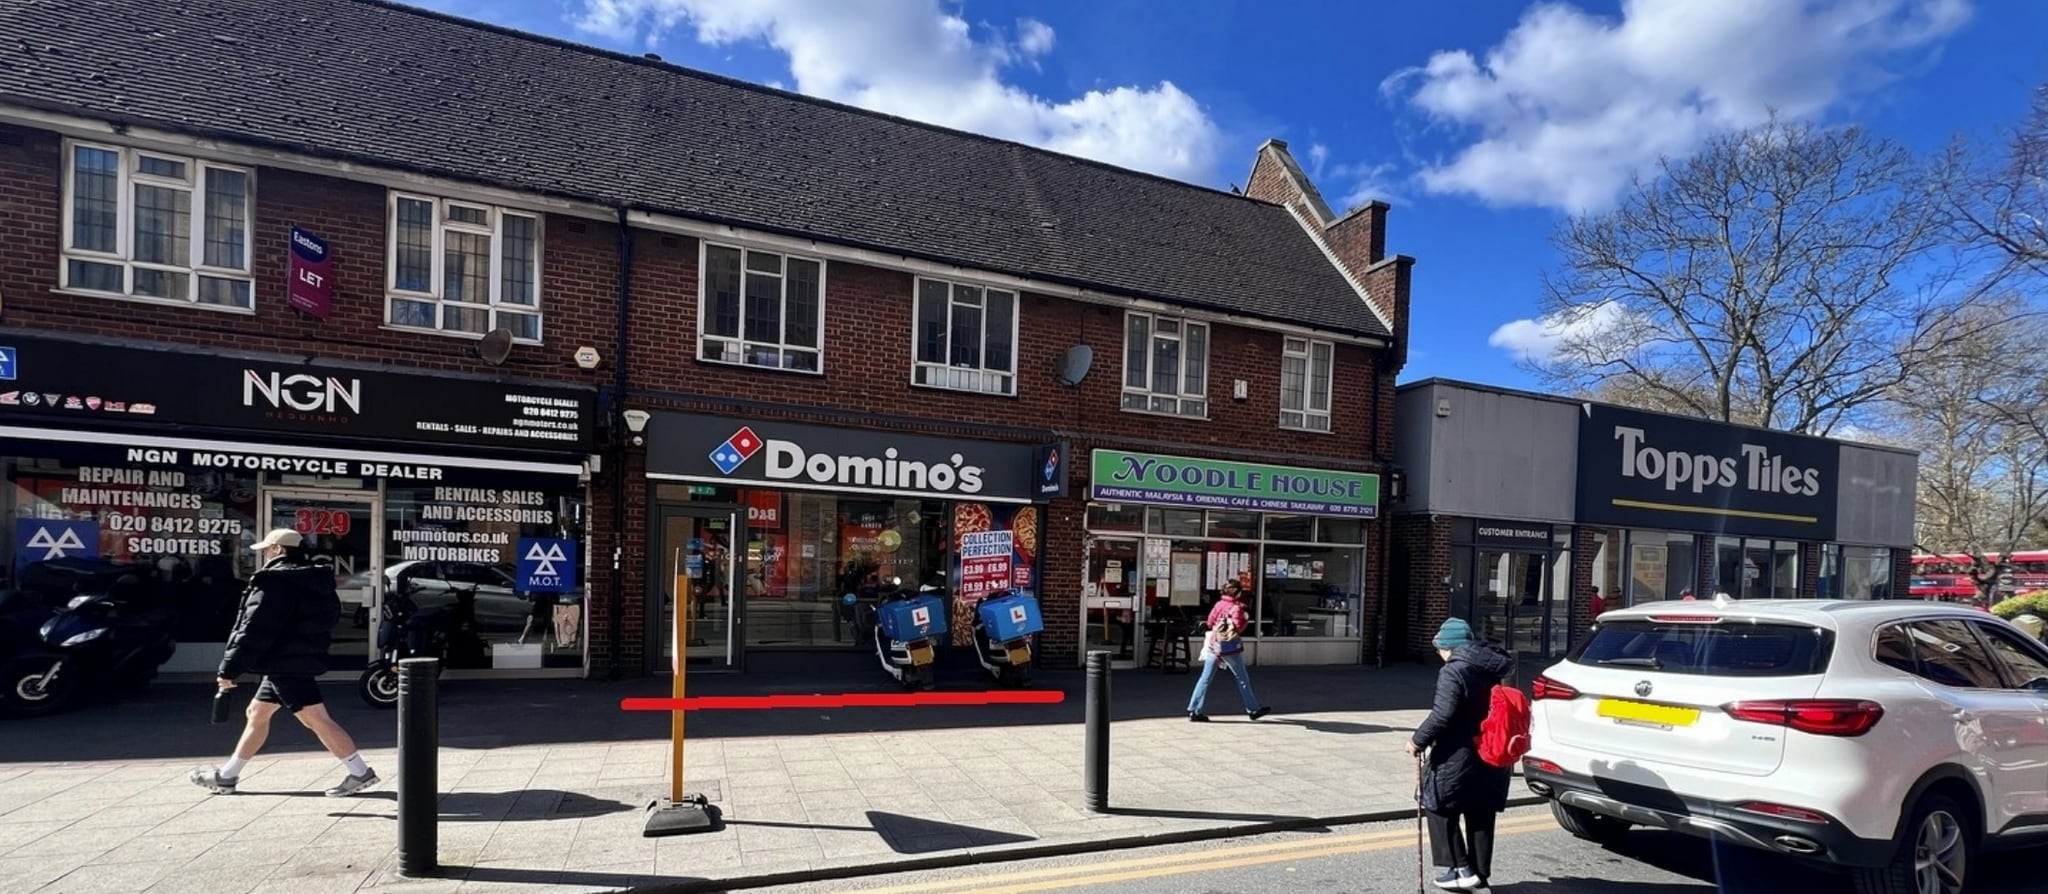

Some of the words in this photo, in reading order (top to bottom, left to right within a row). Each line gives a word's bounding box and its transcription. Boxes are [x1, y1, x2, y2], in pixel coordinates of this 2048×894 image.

[294, 232, 323, 254] Eastons
[300, 268, 323, 288] LET
[243, 369, 360, 414] NGN
[505, 394, 552, 406] MOTORCYCLE
[554, 399, 579, 408] DEALER
[523, 406, 539, 416] 020
[540, 408, 559, 418] 8412
[560, 409, 579, 419] 9275
[416, 422, 449, 431] RENTALS
[454, 424, 477, 434] SALES
[482, 426, 513, 436] REPAIRS
[514, 429, 529, 438] AND
[530, 430, 578, 441] ACCESSORIES
[513, 418, 578, 430] ngnmotors.co.uk
[127, 448, 178, 464] NGN
[192, 452, 348, 474] MOTORCYCLE
[361, 463, 443, 480] DEALER
[765, 439, 983, 493] Domino's
[1614, 425, 1737, 493] Topps
[1741, 443, 1820, 496] Tiles
[79, 466, 144, 484] REPAIR
[148, 470, 185, 486] AND
[1112, 456, 1262, 490] NOODLE
[1271, 474, 1363, 498] HOUSE
[62, 488, 202, 510] MAINTENANCES
[435, 486, 499, 504] RENTALS,
[502, 490, 544, 506] SALES
[1100, 488, 1142, 498] AUTHENTIC
[1145, 492, 1184, 501] MALAYSIA
[1187, 494, 1192, 502] &
[1195, 495, 1228, 504] ORIENTAL
[1260, 501, 1288, 509] CHINESE
[1290, 502, 1325, 510] TAKEAWAY
[110, 515, 146, 532] 020
[151, 516, 194, 534] 8412
[198, 518, 242, 534] 9275
[295, 508, 351, 536] 329
[422, 506, 452, 520] AND
[456, 506, 553, 524] ACCESSORIES
[392, 530, 509, 545] ngnmotors.co.uk
[963, 532, 1012, 546] COLLECTION
[1479, 527, 1513, 537] CUSTOMER
[1515, 530, 1548, 539] ENTRANCE
[128, 538, 222, 555] SCOOTERS
[404, 546, 500, 563] MOTORBIKES
[962, 544, 1012, 557] PERFECTION
[529, 576, 562, 586] M.O.T.
[916, 612, 926, 622] L
[1014, 610, 1022, 619] L
